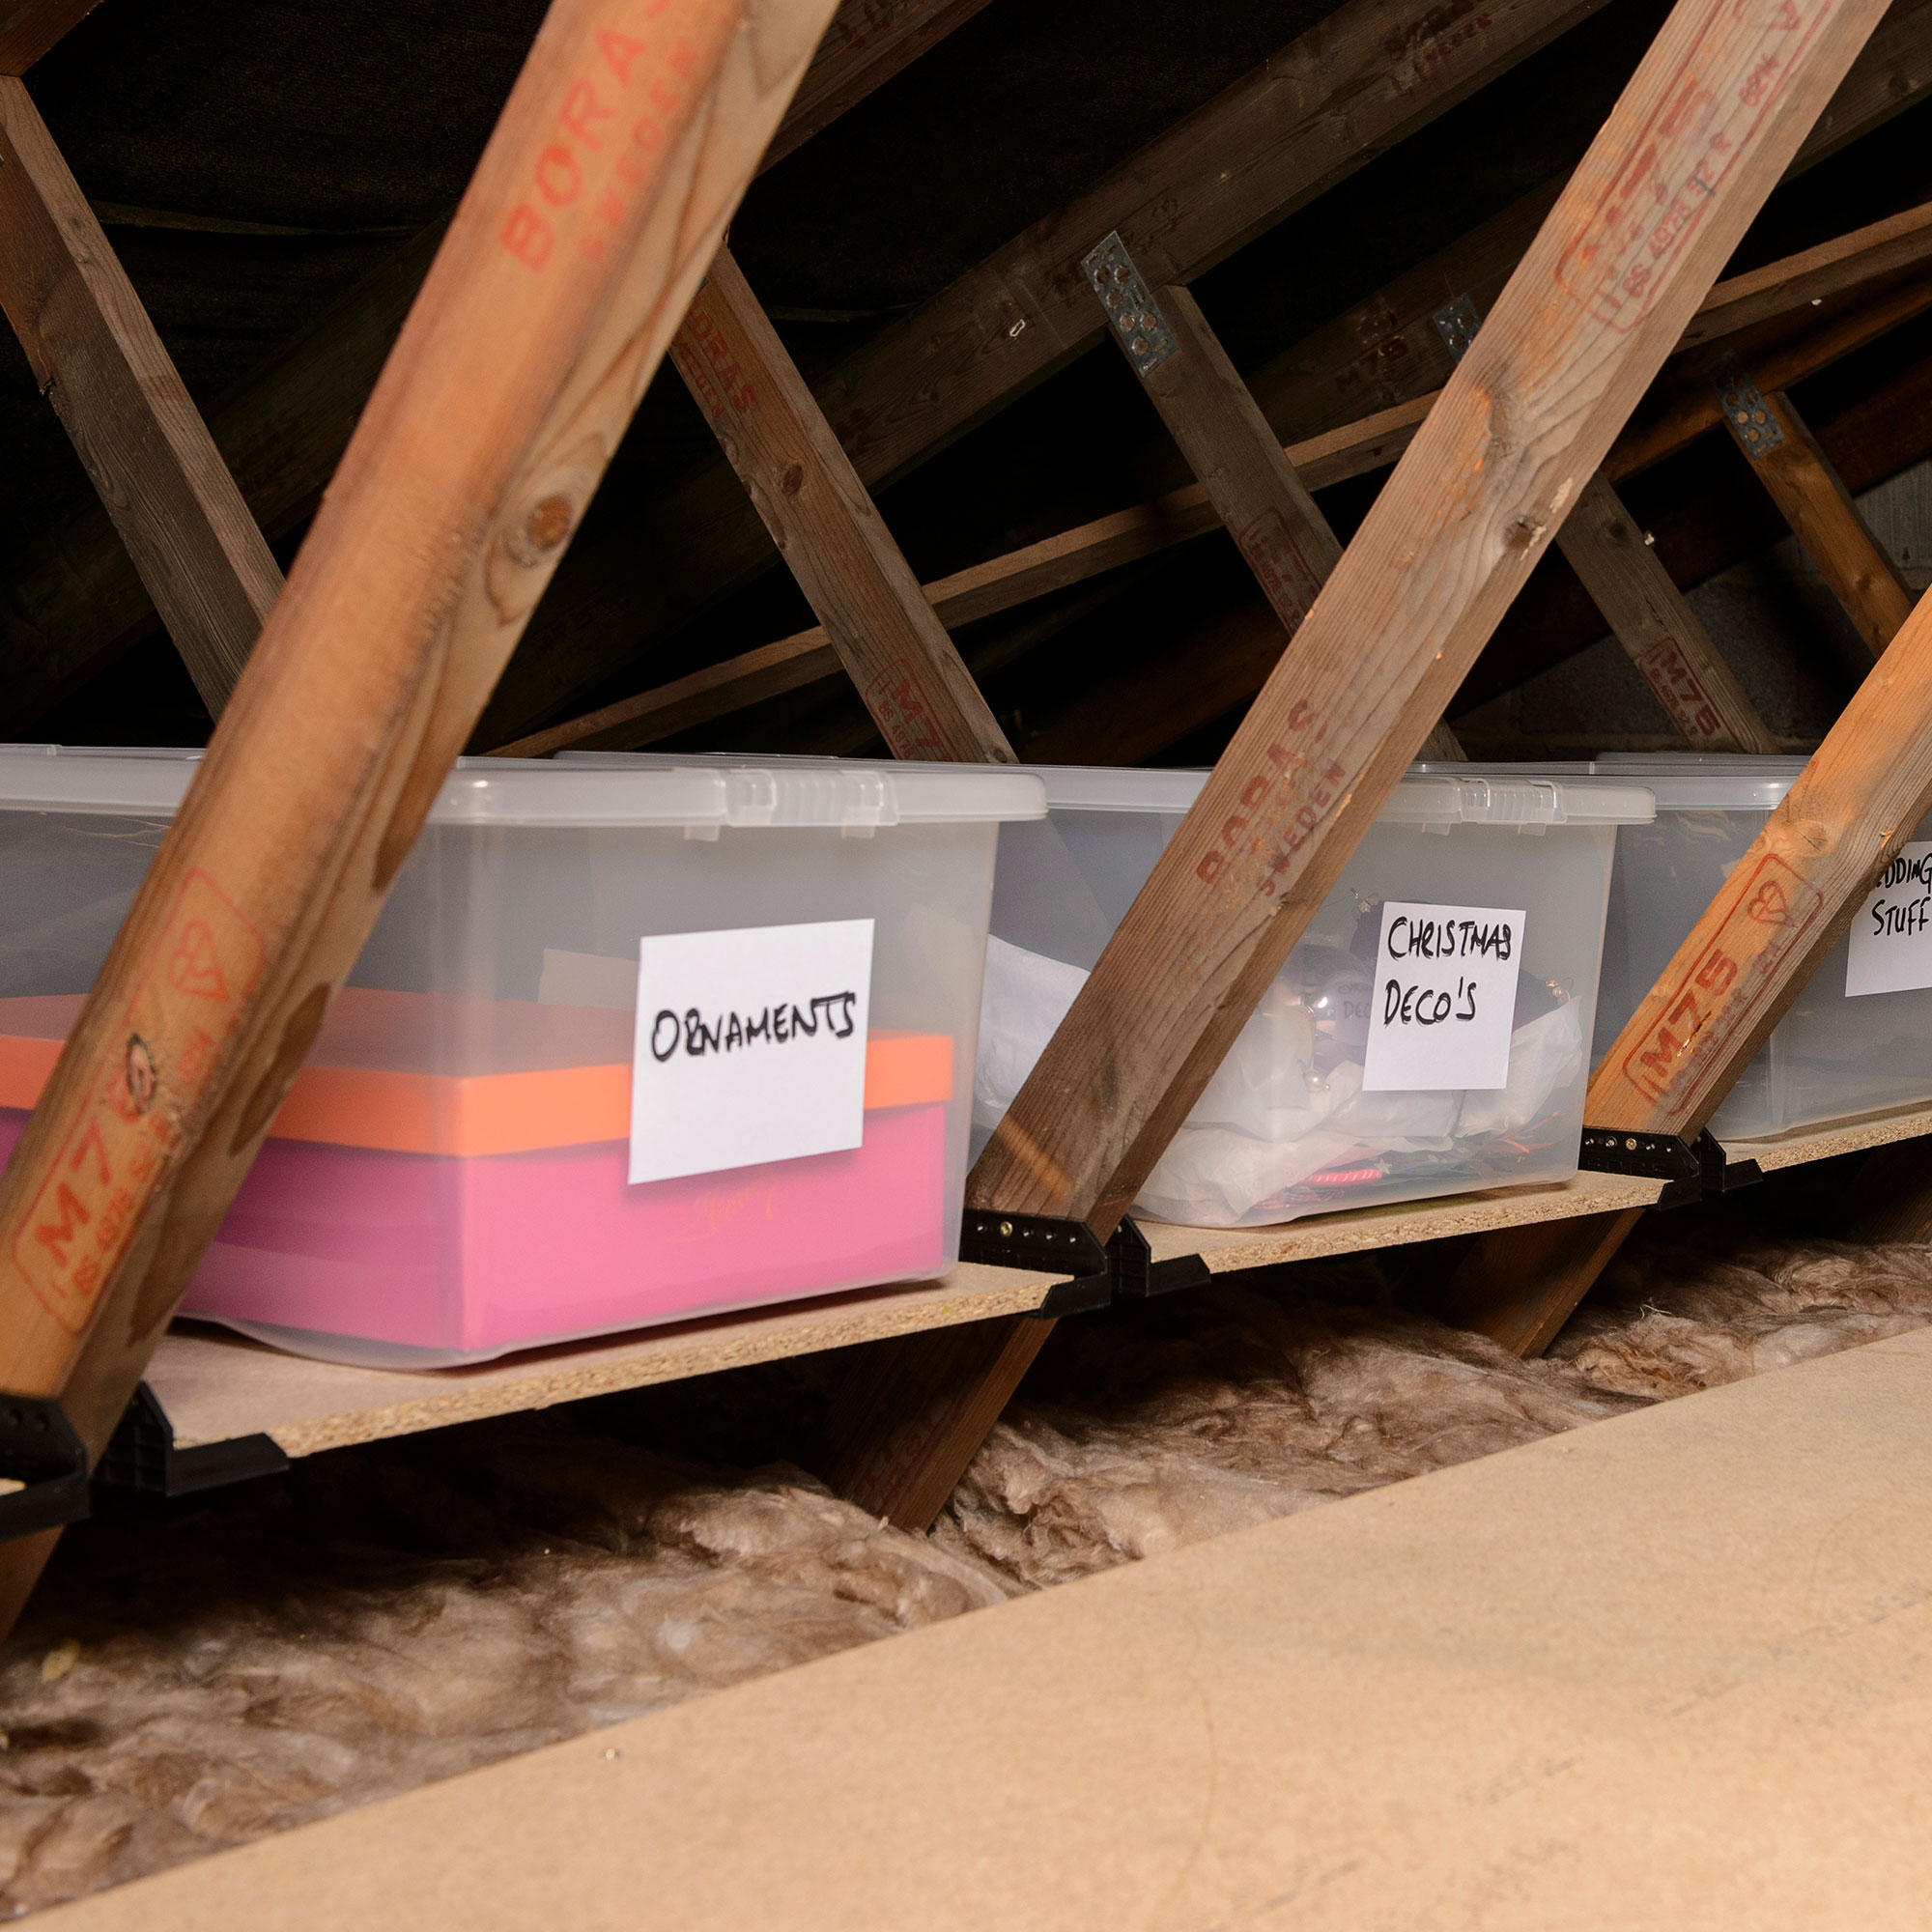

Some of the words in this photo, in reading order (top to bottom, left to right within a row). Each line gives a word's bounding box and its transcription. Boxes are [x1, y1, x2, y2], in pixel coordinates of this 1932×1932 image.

[498, 0, 673, 274] BORA
[1623, 263, 1652, 298] BS
[876, 699, 896, 723] BS
[890, 678, 953, 761] M7
[1660, 651, 1720, 736] M75
[1257, 761, 1346, 896] SWEDEN
[1876, 852, 1932, 894] DDING
[1387, 916, 1512, 961] CHRISTMAS
[1871, 895, 1931, 935] STUFF
[651, 989, 856, 1063] ORNAMENTS
[1383, 976, 1477, 1027] DECO'S
[1640, 948, 1738, 1078] M75
